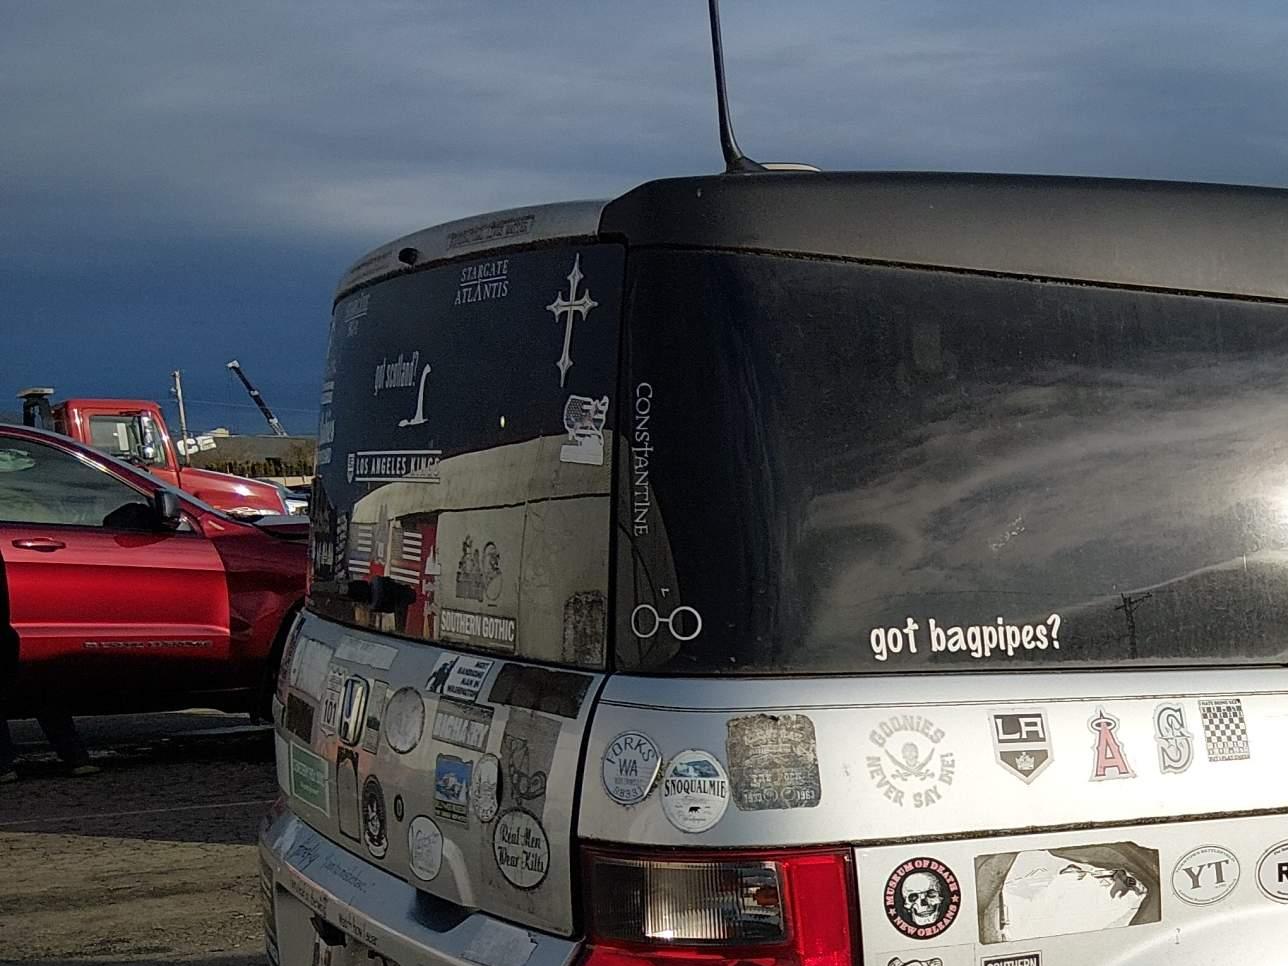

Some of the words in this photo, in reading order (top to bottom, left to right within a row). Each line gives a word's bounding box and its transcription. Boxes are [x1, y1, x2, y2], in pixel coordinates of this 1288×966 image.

[461, 259, 509, 282] STARGATE
[455, 279, 509, 305] ATLANTIS
[373, 357, 387, 396] got
[356, 457, 368, 475] LOS
[371, 457, 406, 475] ANGELES
[410, 457, 441, 477] KINGS
[631, 382, 654, 537] CONSTANTINE
[441, 610, 481, 639] SOUTHERN
[482, 616, 515, 642] GOTHIC
[870, 617, 919, 661] got
[929, 614, 1061, 658] bagpipes?
[324, 699, 337, 728] 101
[995, 717, 1046, 740] LA
[868, 715, 945, 748] GOONIES
[606, 736, 656, 765] FORKS
[619, 759, 638, 777] WA
[866, 755, 904, 807] NEVER
[914, 786, 942, 808] SAY
[939, 752, 955, 785] DIE!
[664, 779, 726, 798] SNOQUALMIE
[501, 823, 520, 845] Real
[886, 864, 914, 905] MUSEUM
[914, 859, 929, 869] OF
[930, 862, 959, 892] DEATH
[1183, 859, 1230, 890] YT
[894, 915, 917, 936] NEW
[918, 904, 957, 937] ORLEANS
